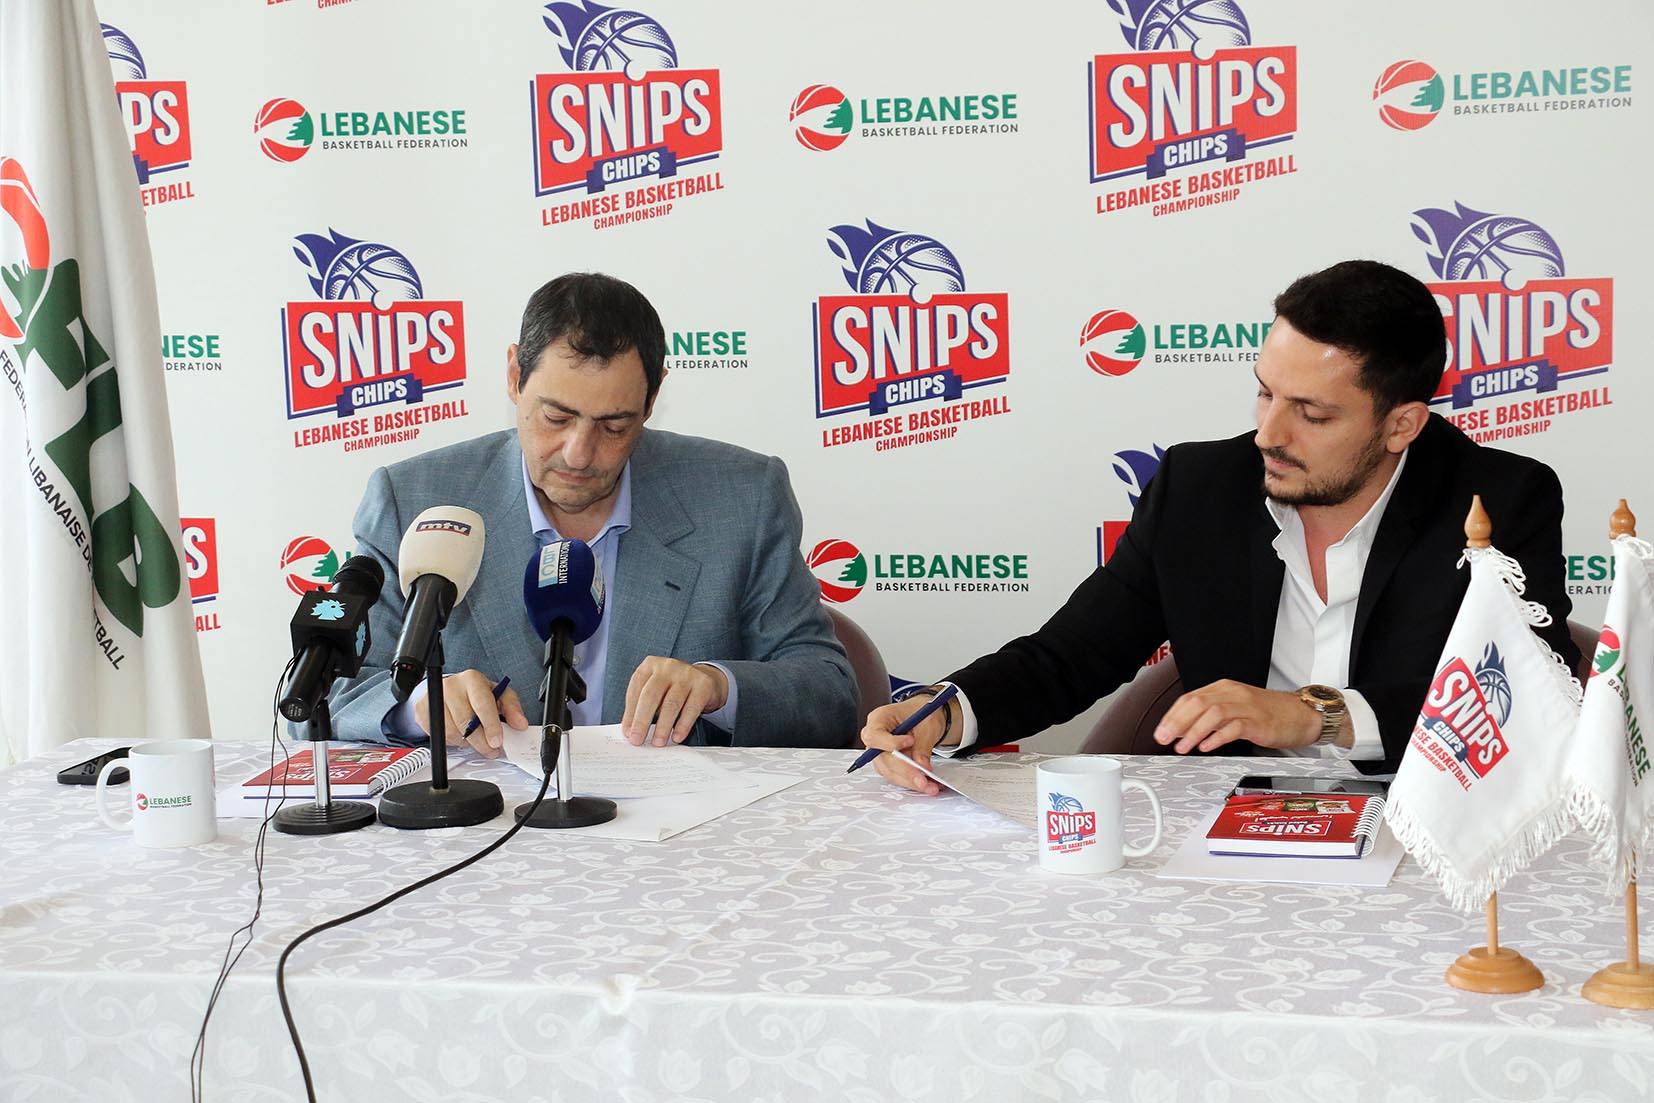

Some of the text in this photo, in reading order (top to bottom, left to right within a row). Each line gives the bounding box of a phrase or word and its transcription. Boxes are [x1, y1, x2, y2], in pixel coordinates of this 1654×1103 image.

[1453, 65, 1632, 101] LEBANESE
[860, 94, 1018, 124] LEBANESE
[1454, 97, 1632, 115] BASKETBALL FEDERATION
[320, 110, 467, 136] LEBANESE
[862, 123, 1019, 138] BASKETBALL FEDERATION
[322, 138, 468, 150] BASKETBALL FEDERATION
[1163, 133, 1228, 167] CHIPS
[602, 151, 661, 181] CHIPS
[1096, 154, 1298, 214] LEBANESE BASKETBALL
[542, 172, 724, 226] LEBANESE BASKETBALL
[1152, 188, 1240, 217] CHAMPIONSHIP
[593, 203, 673, 230] CHAMPIONSHIP
[676, 359, 748, 369] FEDERATION
[1154, 352, 1234, 363] BASKETBALL
[351, 378, 408, 406] CHIPS
[885, 374, 946, 404] CHIPS
[1471, 365, 1539, 396] CHIPS
[1496, 387, 1613, 425] BASKETBALL
[294, 400, 469, 448] LEBANESE BASKETBALL
[822, 395, 1011, 447] LEBANESE BASKETBALL
[343, 428, 420, 452] CHAMPIONSHIP
[876, 426, 958, 452] CHAMPIONSHIP
[28, 456, 87, 548] LIBANAISE
[420, 522, 468, 534] mtv
[874, 554, 1028, 579] LEBANESE
[876, 582, 1029, 592] BASKETBALL FEDERATION
[1432, 721, 1465, 753] CHIPS
[1428, 741, 1473, 792] BASKETBALL
[149, 795, 192, 805] LEBANESE
